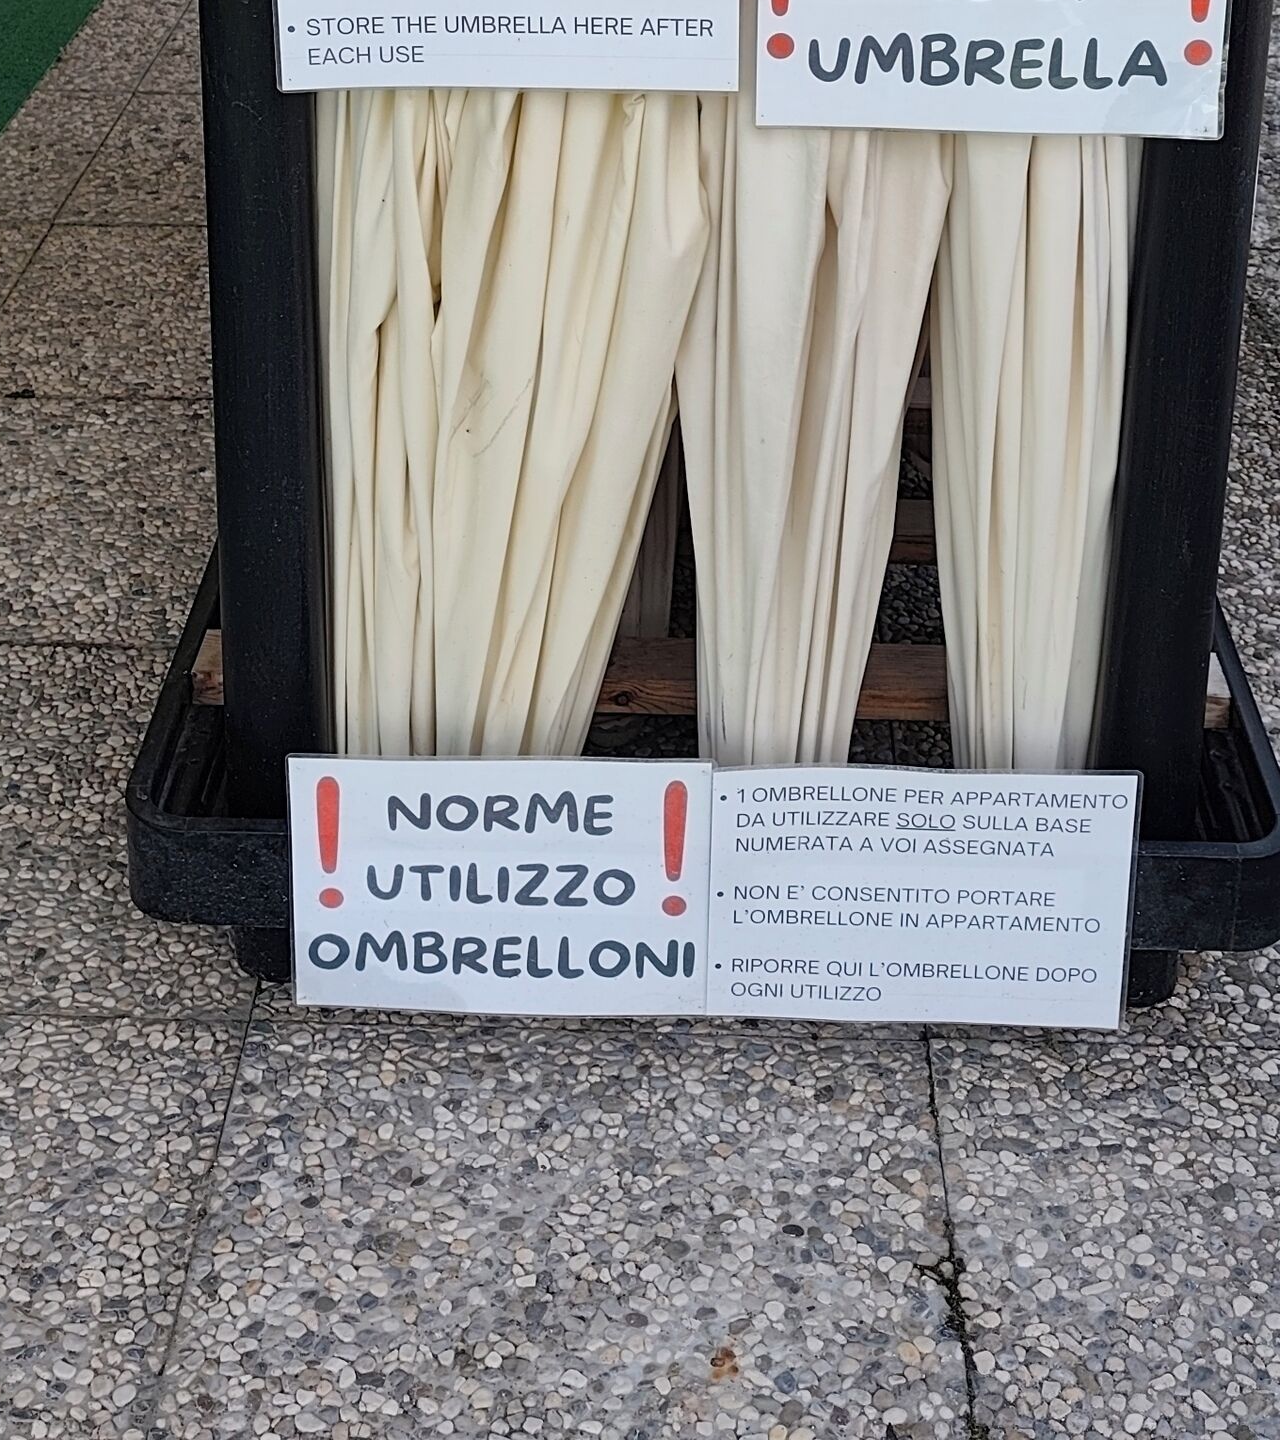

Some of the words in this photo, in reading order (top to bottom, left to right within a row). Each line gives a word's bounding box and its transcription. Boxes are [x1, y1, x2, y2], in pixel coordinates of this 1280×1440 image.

[306, 16, 385, 37] STORE
[390, 15, 438, 34] THE
[444, 15, 567, 35] UMBRELLA
[573, 16, 634, 36] HERE
[639, 17, 714, 38] AFTER
[307, 46, 372, 66] EACH
[379, 45, 425, 64] USE
[808, 32, 1168, 91] UMBRELLA
[736, 788, 745, 804] 1
[751, 785, 898, 803] OMBRELLONE
[904, 788, 944, 806] PER
[949, 791, 1129, 810] APPARTAMENTO
[387, 790, 614, 837] NORME
[736, 812, 766, 829] DA
[772, 810, 891, 828] UTILIZZARE
[895, 812, 957, 832] SOLO
[962, 814, 1029, 832] SULLA
[1035, 817, 1092, 834] BASE
[735, 835, 854, 853] NUMERATA
[858, 836, 874, 853] A
[880, 836, 917, 854] VOI
[922, 838, 1055, 858] ASSEGNATA
[366, 862, 636, 908] UTILIZZO
[733, 884, 780, 901] NON
[811, 885, 951, 905] CONSENTITO
[957, 889, 1056, 908] PORTARE
[900, 912, 920, 928] IN
[925, 913, 1101, 934] APPARTAMENTO
[307, 929, 696, 980] OMBRELLONI
[731, 957, 821, 975] RIPORRE
[826, 960, 863, 978] QUI
[1035, 966, 1098, 984] DOPO
[730, 981, 783, 998] OGNI
[790, 983, 882, 1002] UTILIZZO
